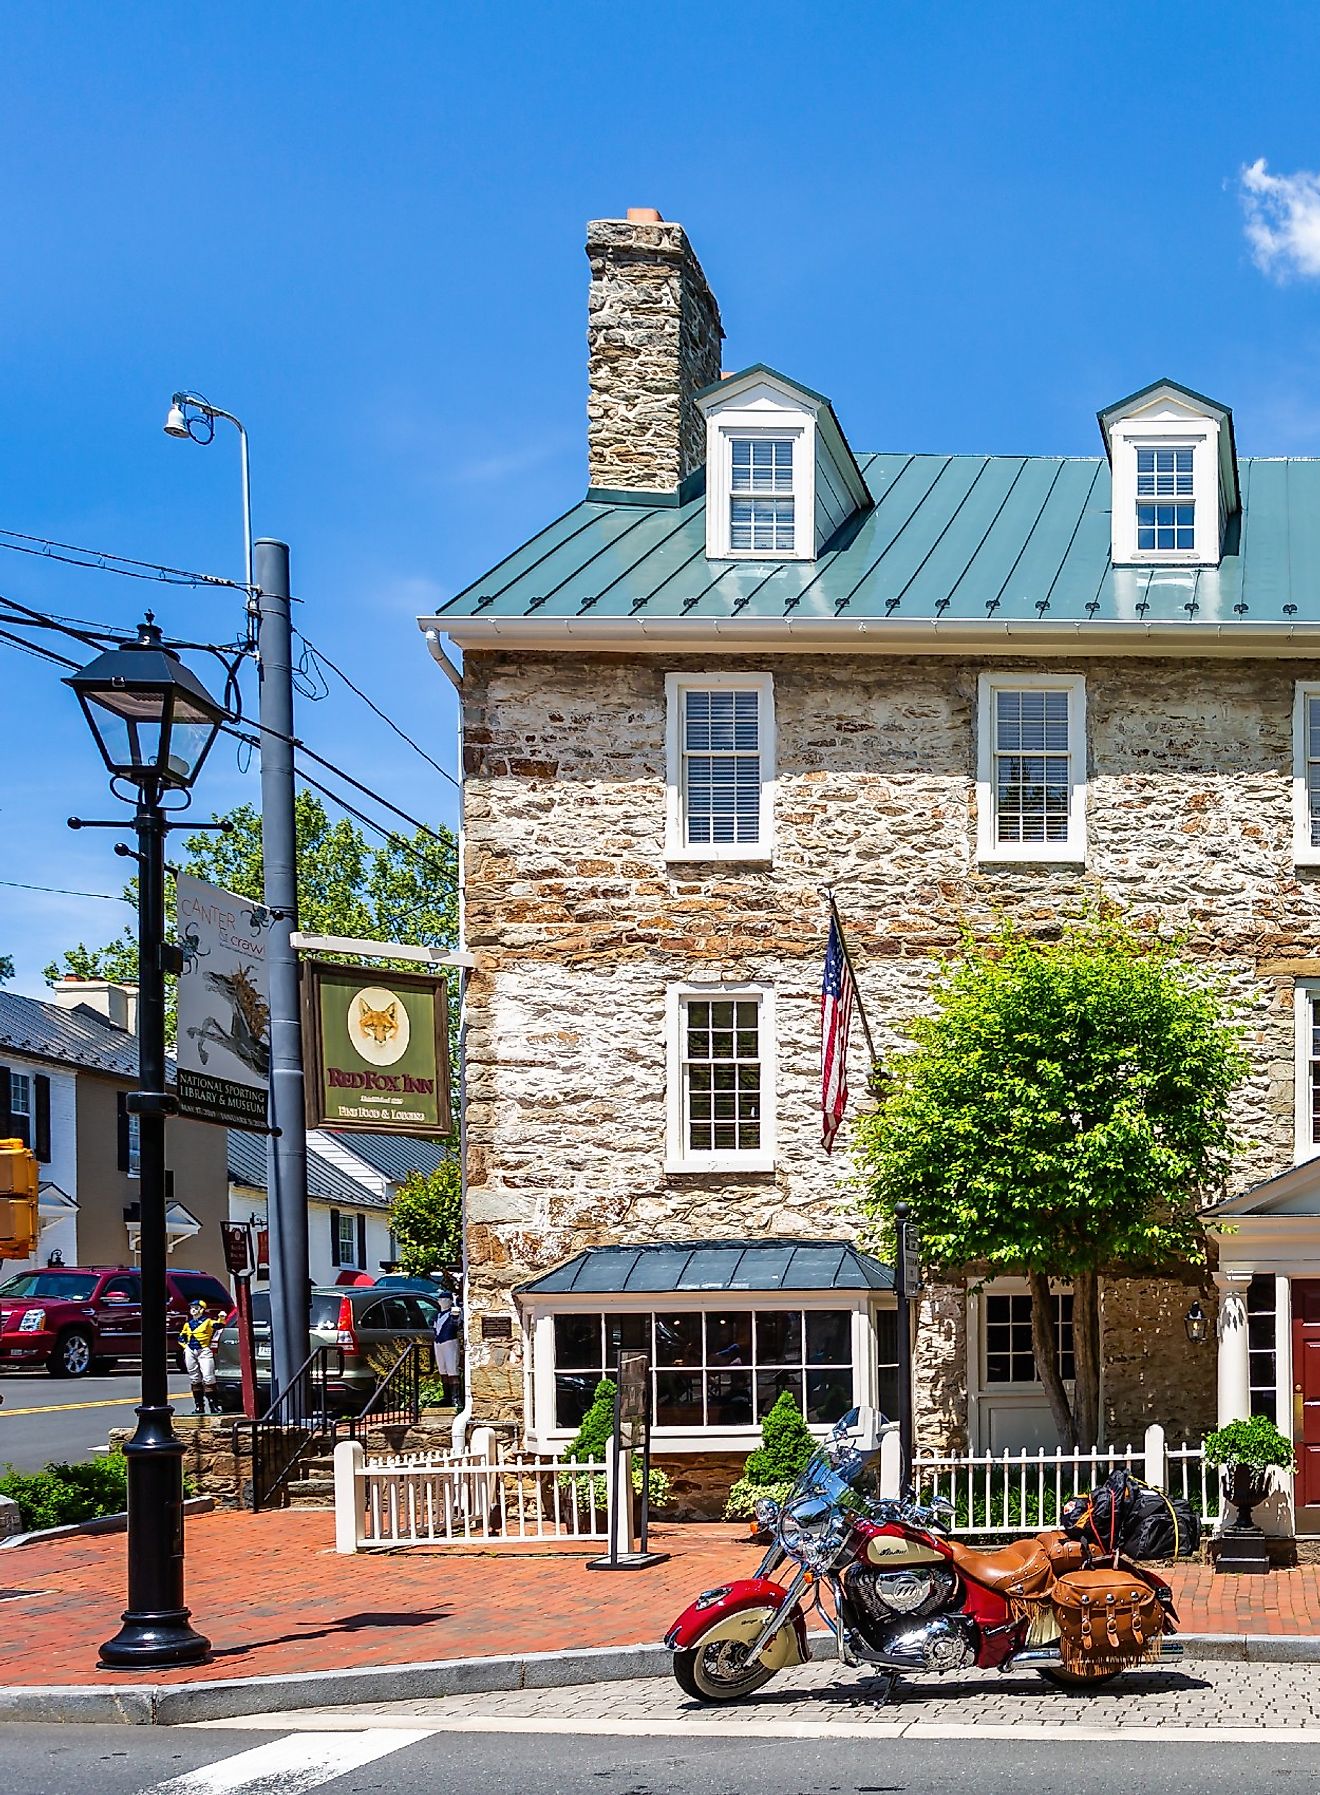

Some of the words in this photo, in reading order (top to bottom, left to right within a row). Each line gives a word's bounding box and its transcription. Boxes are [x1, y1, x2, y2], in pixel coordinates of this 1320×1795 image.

[181, 896, 236, 930] CANTER
[180, 1073, 223, 1093] NATIONAL
[225, 1083, 265, 1103] SPORTING
[327, 1067, 363, 1088] RED
[363, 1070, 401, 1092] FOX
[401, 1073, 434, 1095] INN
[180, 1085, 217, 1104] LIBRARY
[218, 1094, 226, 1106] &
[227, 1096, 265, 1115] MUSEUM
[381, 1108, 391, 1119] &
